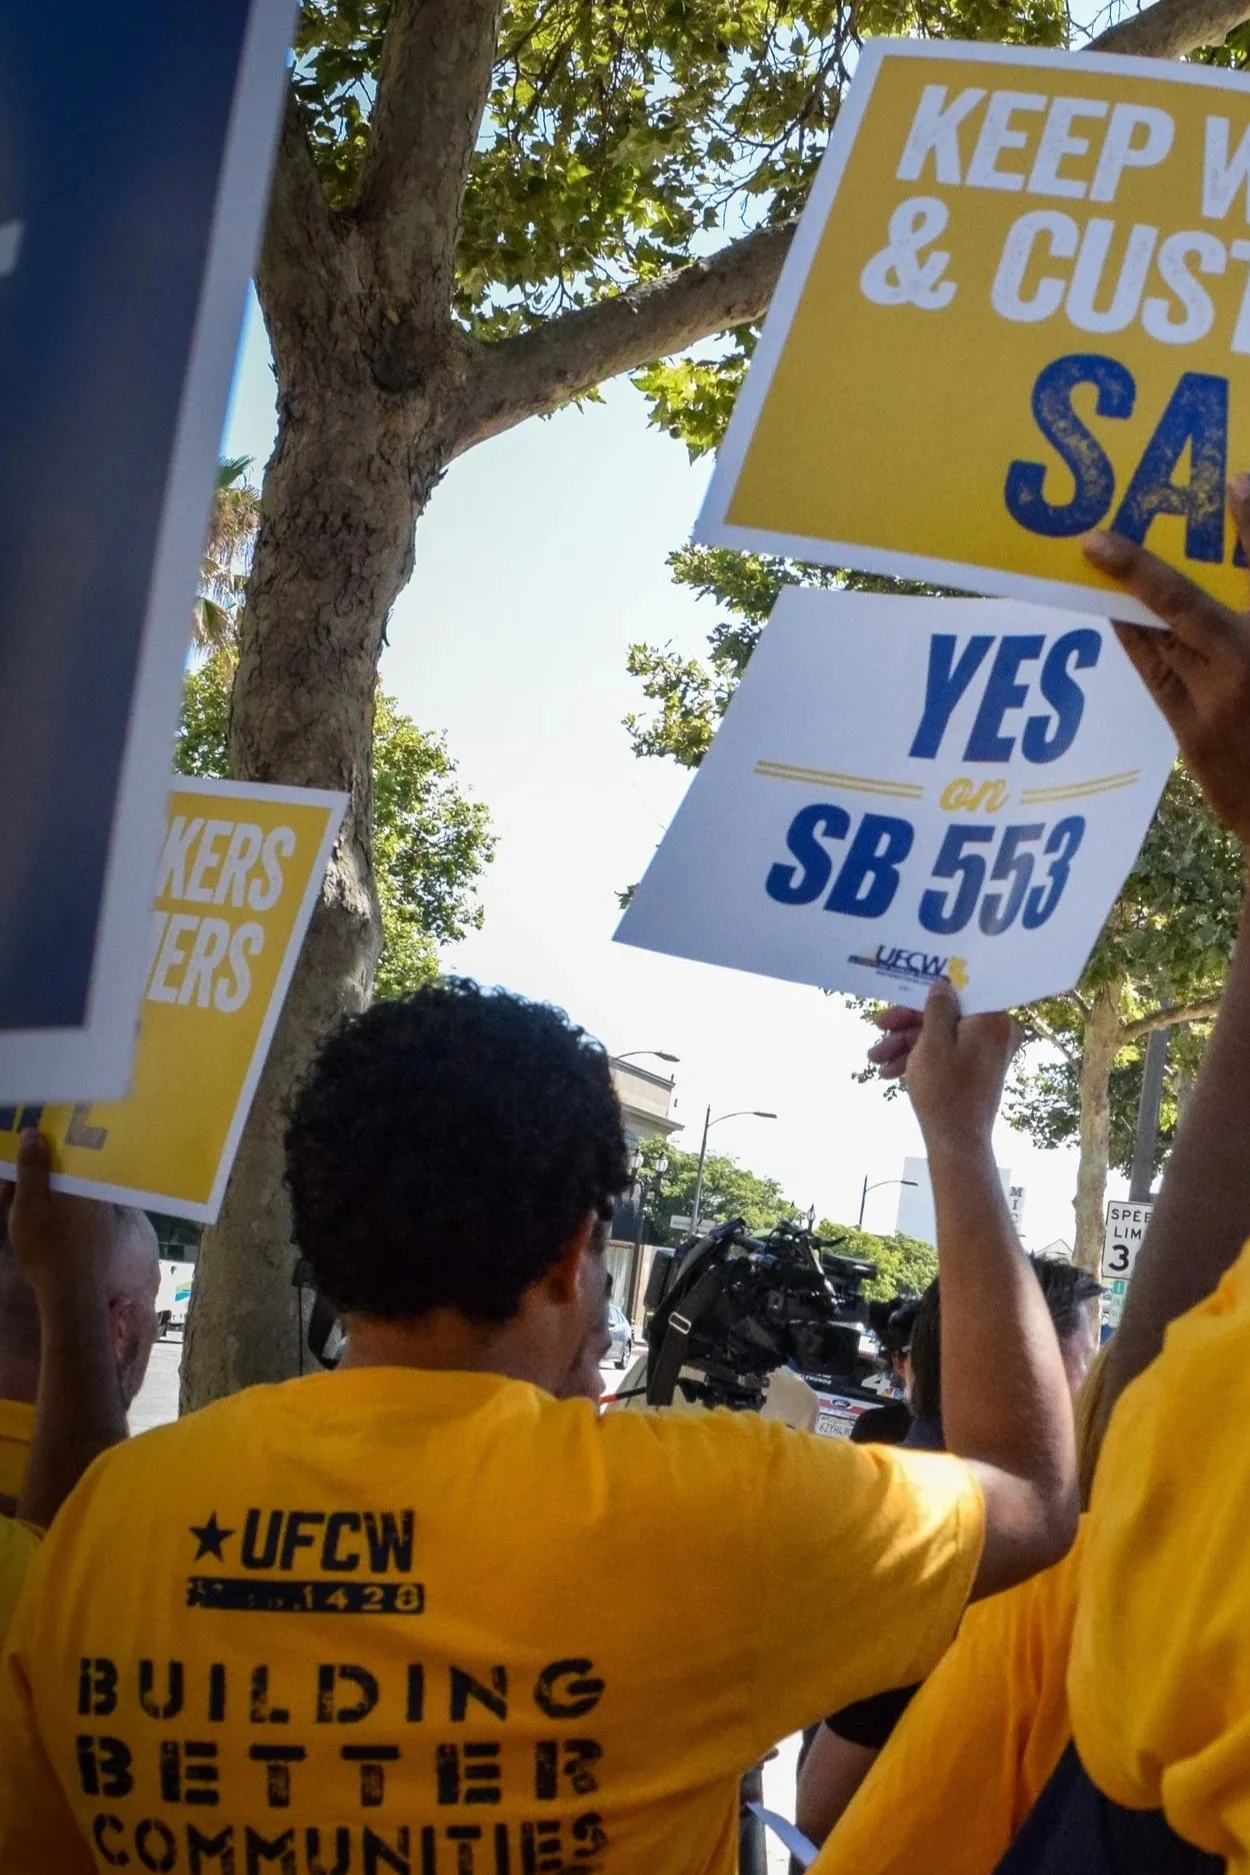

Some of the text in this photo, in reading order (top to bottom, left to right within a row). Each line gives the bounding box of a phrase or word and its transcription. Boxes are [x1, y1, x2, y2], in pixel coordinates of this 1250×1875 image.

[897, 84, 1175, 202] KEEP
[860, 195, 957, 311] &
[908, 628, 1102, 763] YES
[939, 777, 1010, 814] on
[765, 803, 1086, 936] SB 553
[145, 911, 265, 1014] ERS
[876, 944, 949, 977] UFCW
[1114, 1226, 1142, 1240] LIM
[241, 1508, 415, 1573] UFCW
[302, 1584, 421, 1611] 1428
[76, 1657, 606, 1724] BUILDING
[75, 1732, 604, 1807] BETTER
[91, 1811, 608, 1875] COMMUNITIES
